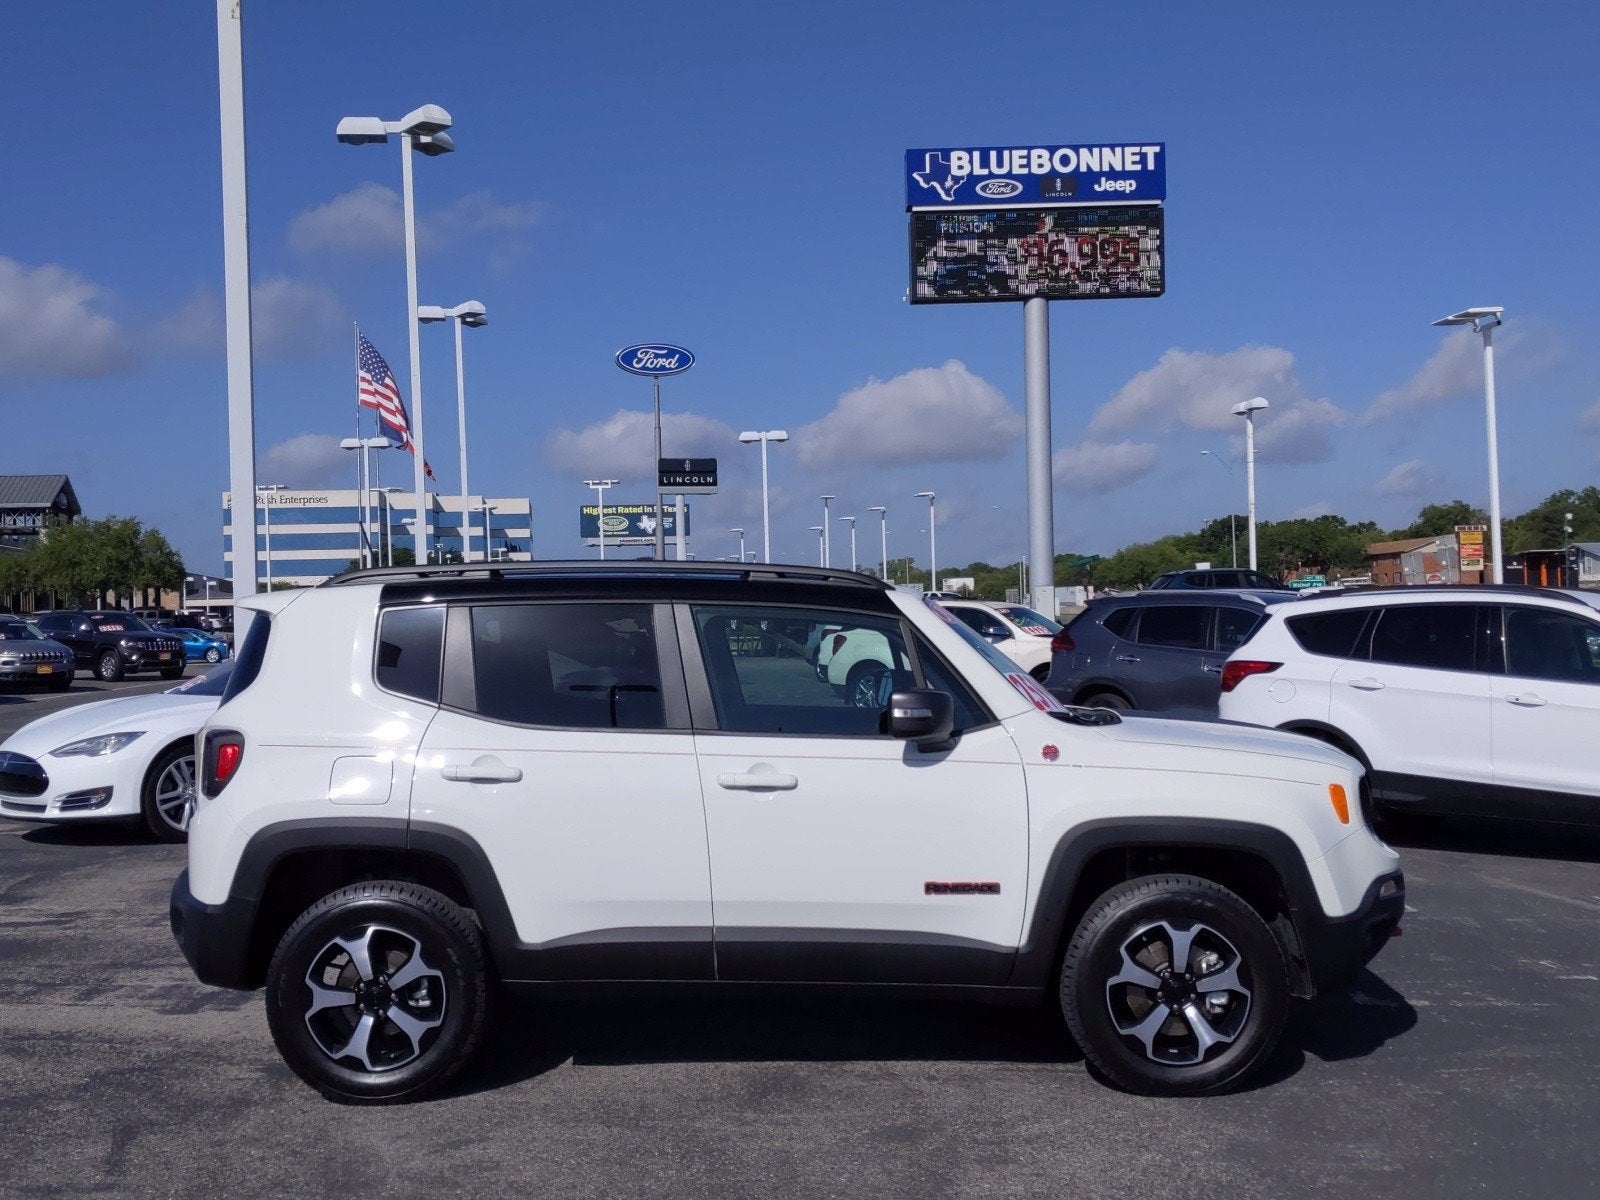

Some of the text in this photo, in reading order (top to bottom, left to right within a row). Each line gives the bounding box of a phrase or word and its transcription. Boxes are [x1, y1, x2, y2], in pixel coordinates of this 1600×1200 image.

[950, 146, 1160, 176] BLUEBONNET
[1094, 177, 1136, 193] Jeep
[632, 348, 679, 369] Ford
[663, 476, 713, 484] LINCOLN
[279, 493, 329, 506] Enterprises
[583, 506, 617, 515] Higest
[617, 506, 643, 514] Rated
[924, 882, 1001, 895] RENEGADE
